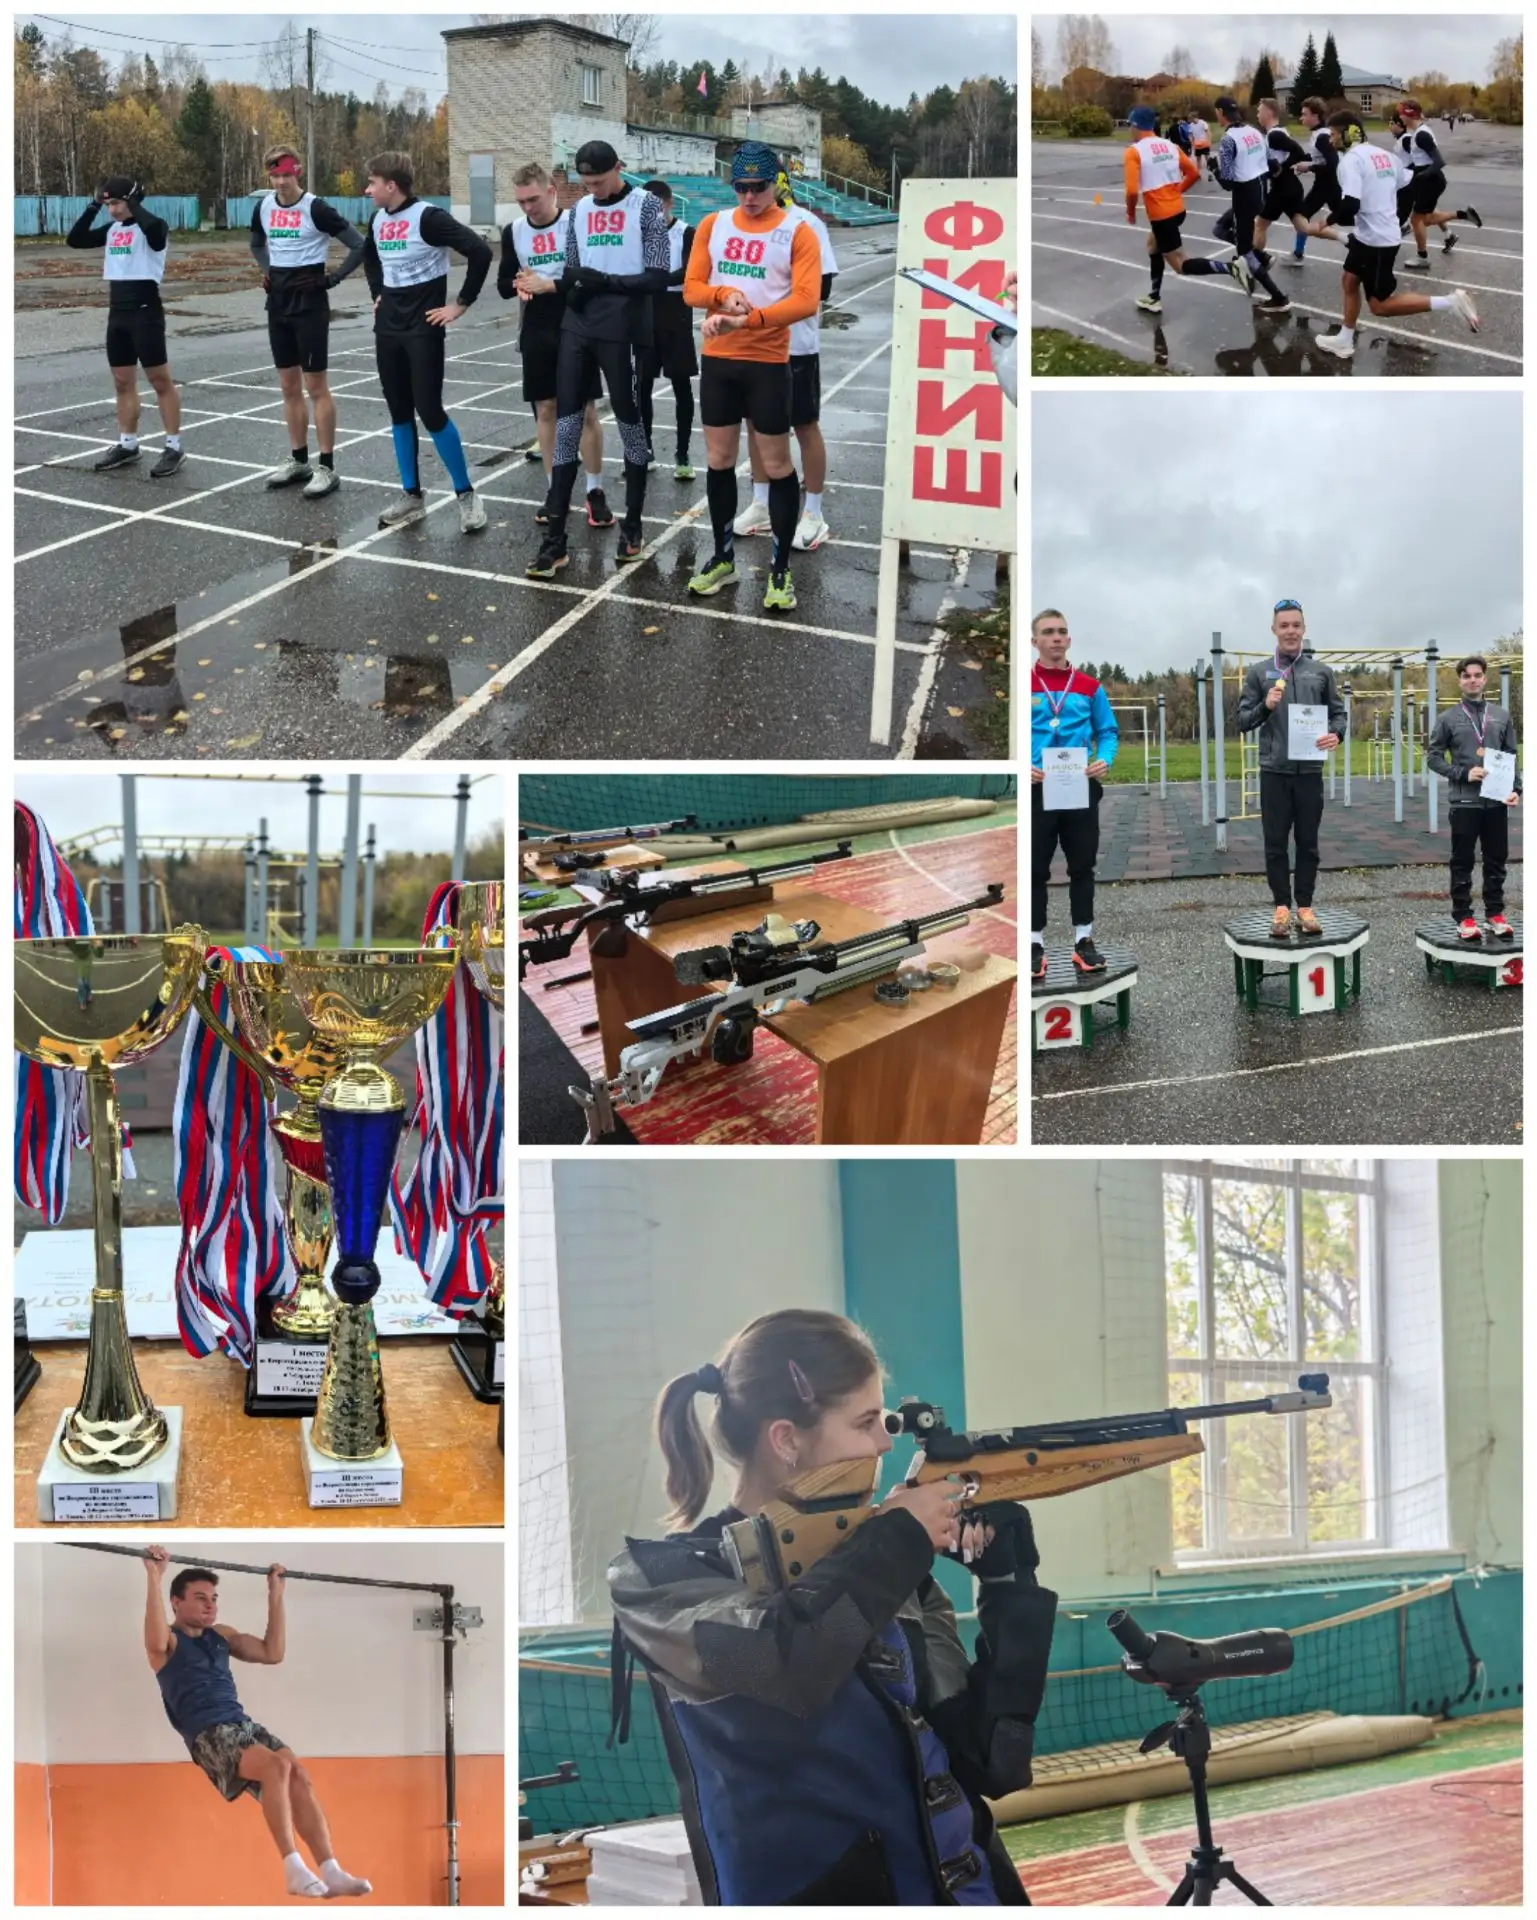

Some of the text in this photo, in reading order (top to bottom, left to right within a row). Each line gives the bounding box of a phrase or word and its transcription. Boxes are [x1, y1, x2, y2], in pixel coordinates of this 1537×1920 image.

[270, 209, 301, 228] 153
[379, 220, 409, 241] 132
[587, 210, 625, 235] 169
[532, 231, 556, 254] 81
[724, 236, 766, 264] 80
[717, 260, 766, 280] СЕВЕРСК
[912, 200, 1005, 508] ФИНИШ
[1308, 967, 1324, 997] 1
[1502, 958, 1524, 985] 3
[1044, 1006, 1073, 1041] 2
